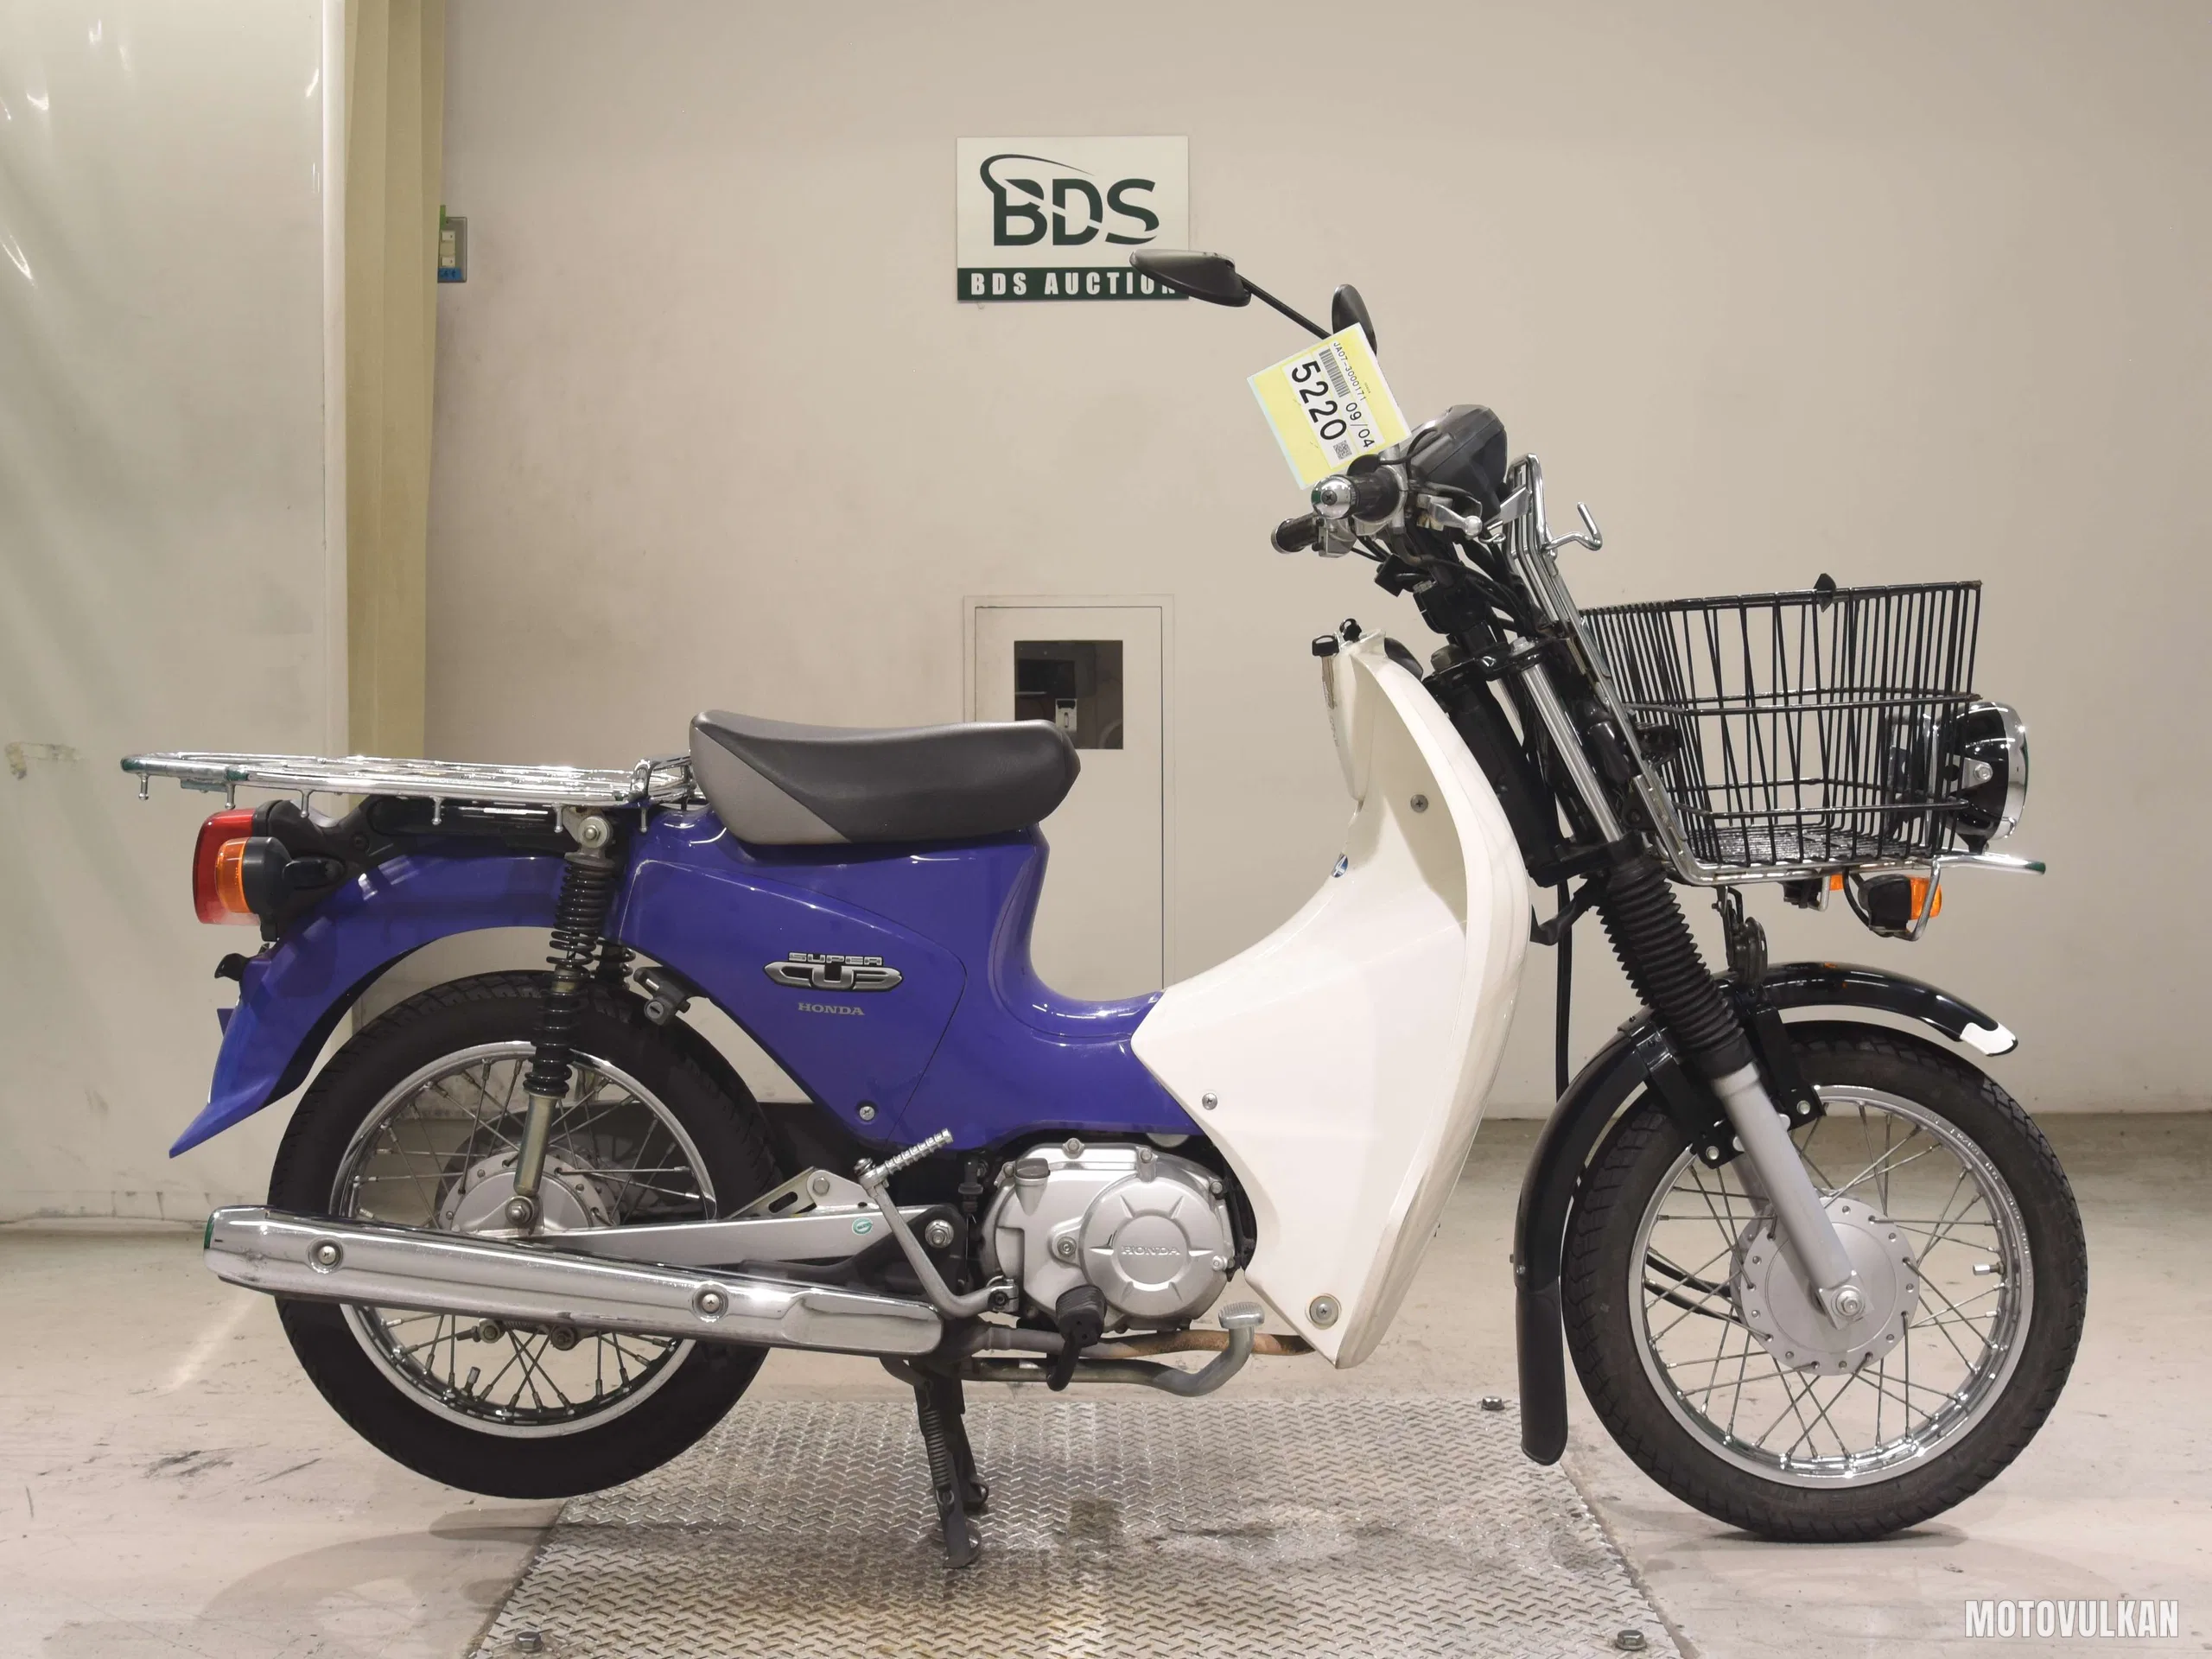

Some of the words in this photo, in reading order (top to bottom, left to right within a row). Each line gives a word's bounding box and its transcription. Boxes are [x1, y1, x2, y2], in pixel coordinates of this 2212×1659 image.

[984, 168, 1160, 246] BDS
[970, 273, 1027, 296] BDS
[1333, 342, 1366, 401] JA07-3000171
[1291, 360, 1347, 441] 5220
[1345, 402, 1375, 448] 09/04
[788, 952, 883, 966] SUPER
[798, 1002, 865, 1015] HONDA
[1121, 1246, 1181, 1256] HONDA
